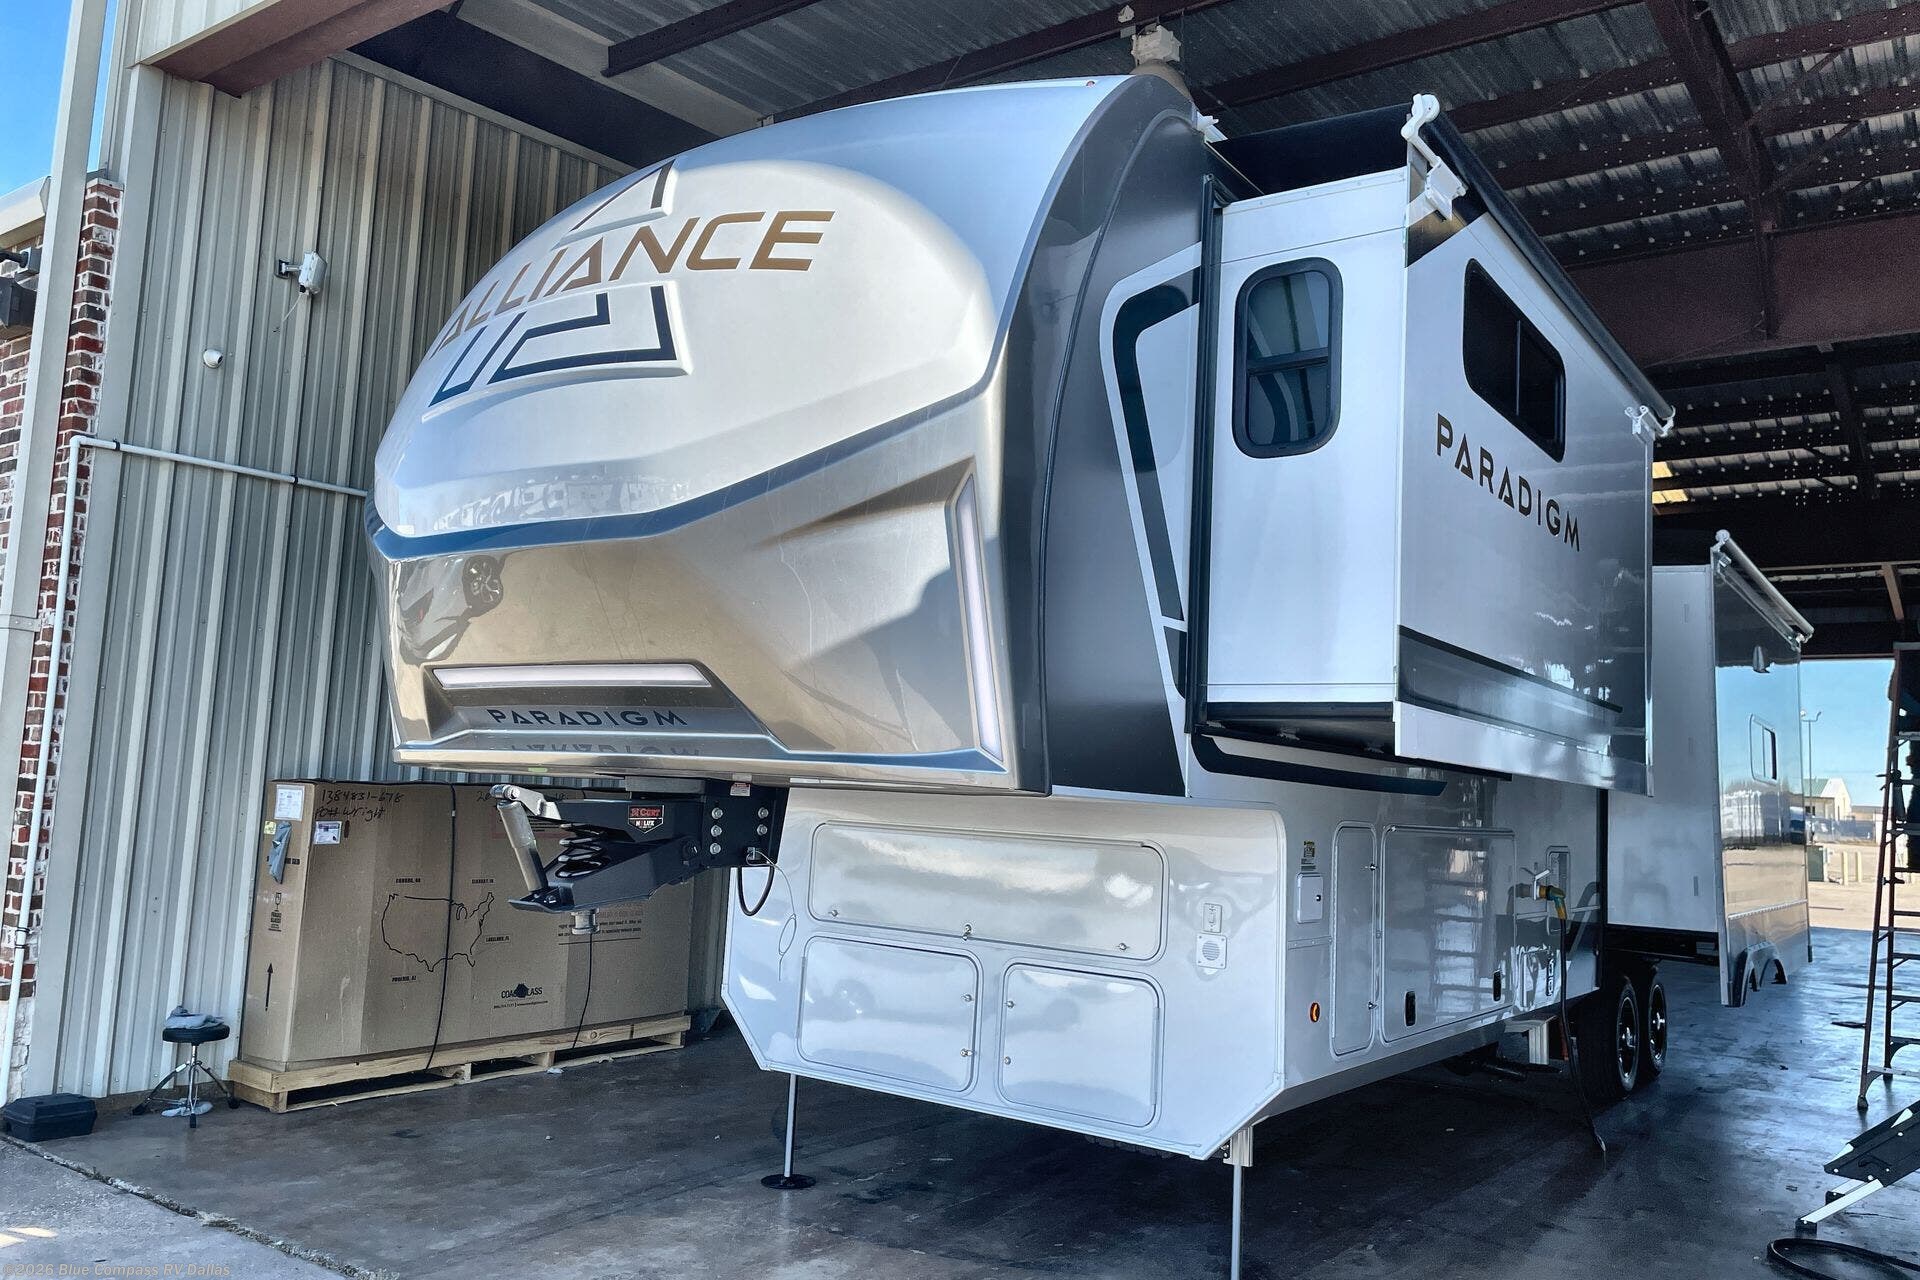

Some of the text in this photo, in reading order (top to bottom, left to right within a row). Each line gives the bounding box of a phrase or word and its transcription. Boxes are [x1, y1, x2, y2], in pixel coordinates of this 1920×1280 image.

[430, 211, 835, 358] ALLIANCE
[1437, 412, 1580, 552] PARADIGM
[486, 709, 688, 726] PARADIGM
